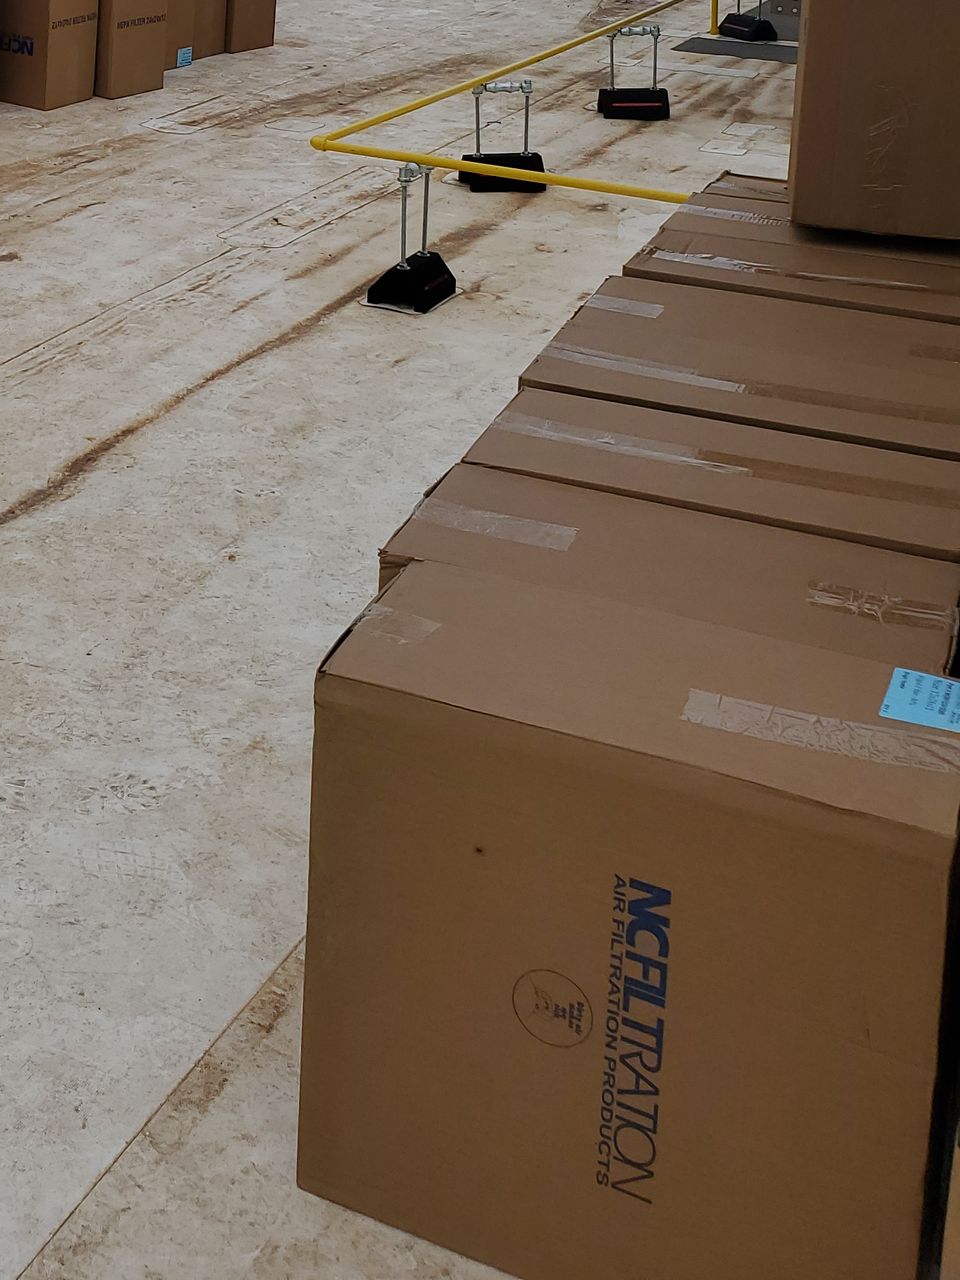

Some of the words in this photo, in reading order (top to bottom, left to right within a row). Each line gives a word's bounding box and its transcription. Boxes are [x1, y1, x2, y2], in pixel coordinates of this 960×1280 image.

[613, 873, 627, 913] AIR
[605, 918, 625, 1051] FILTRATION
[611, 877, 671, 1204] NCFILTRATION
[596, 1056, 616, 1187] PRODUCTS
